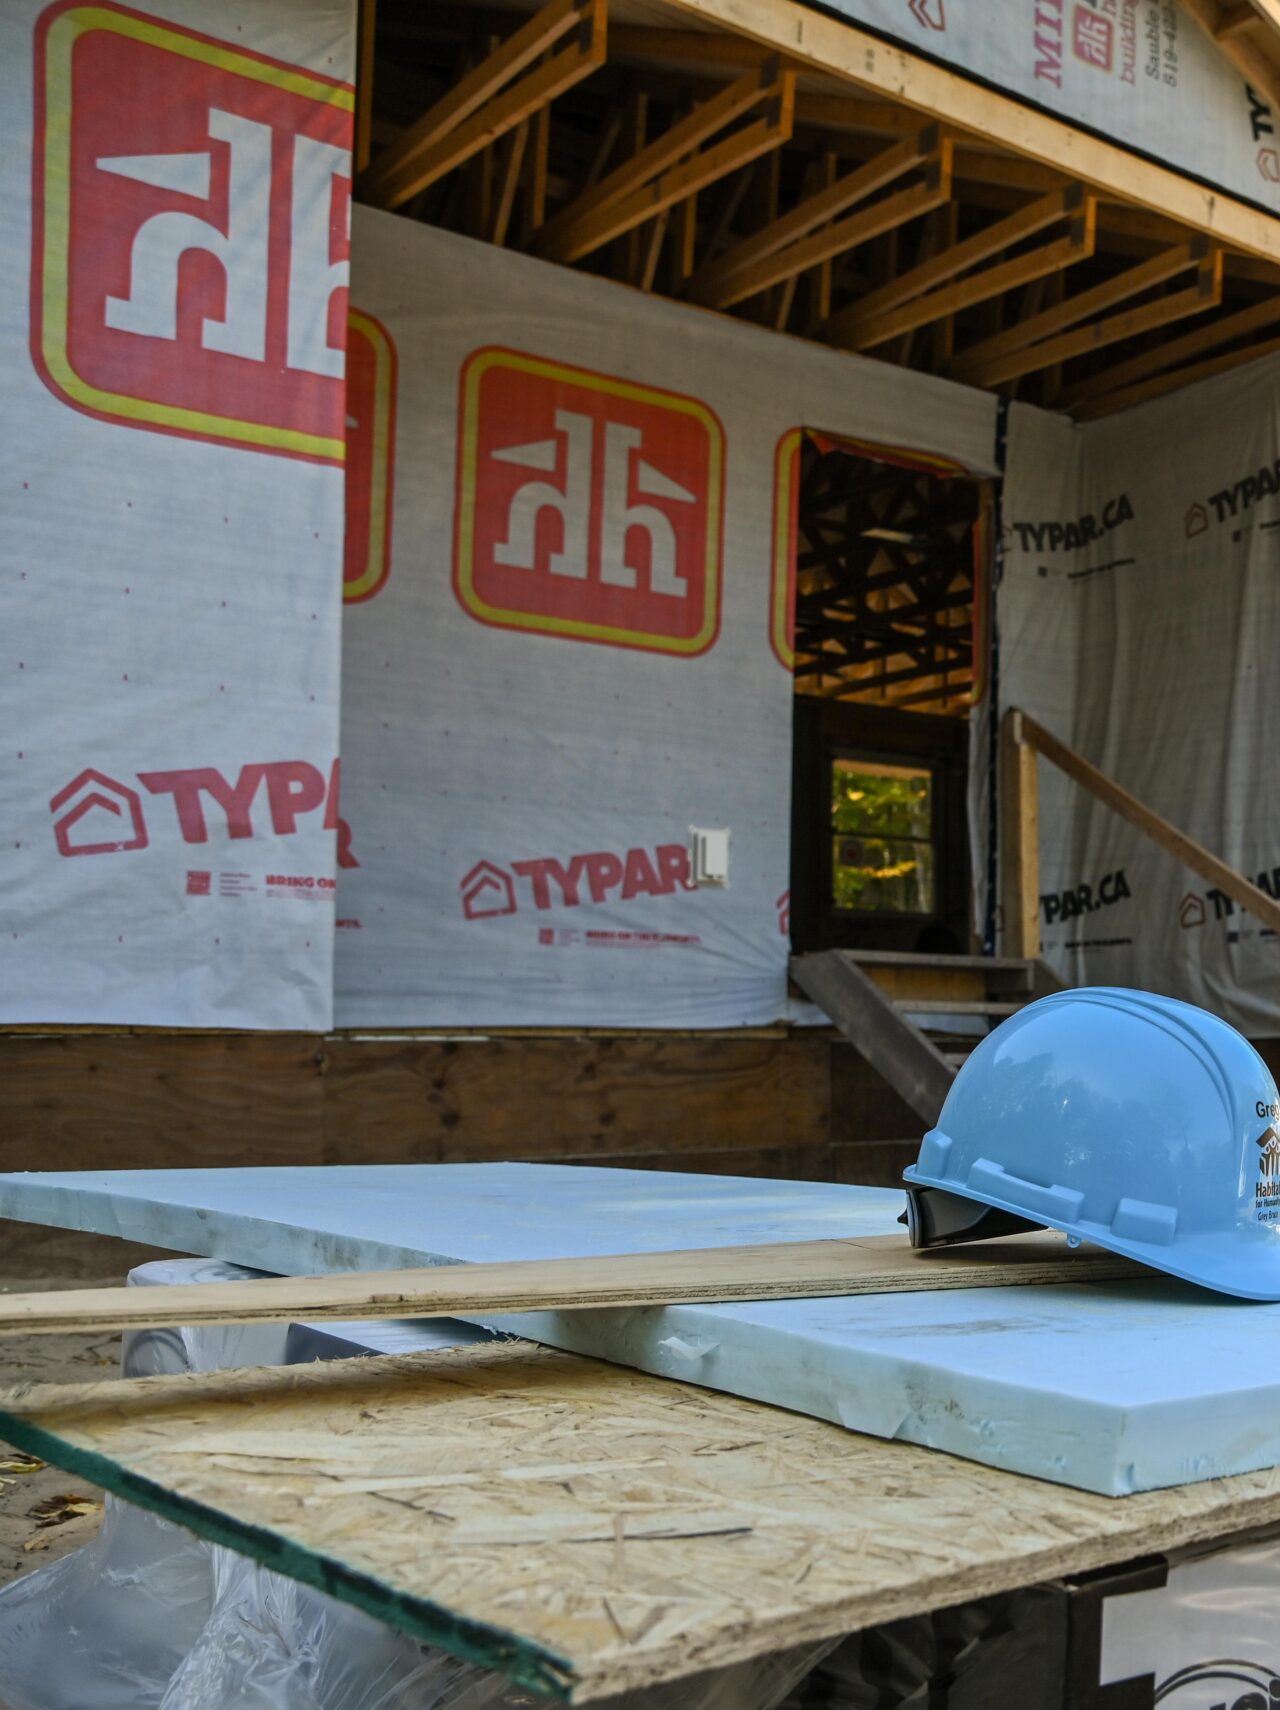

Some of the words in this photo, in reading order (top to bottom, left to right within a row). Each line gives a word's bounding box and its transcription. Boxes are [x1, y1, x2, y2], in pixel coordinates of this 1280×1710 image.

[1245, 82, 1274, 142] TY
[1013, 494, 1135, 551] TYPAR.CA
[265, 874, 315, 889] BRING
[511, 843, 699, 911] TYPAR
[1255, 1180, 1280, 1198] Habitat
[1255, 1199, 1263, 1209] for
